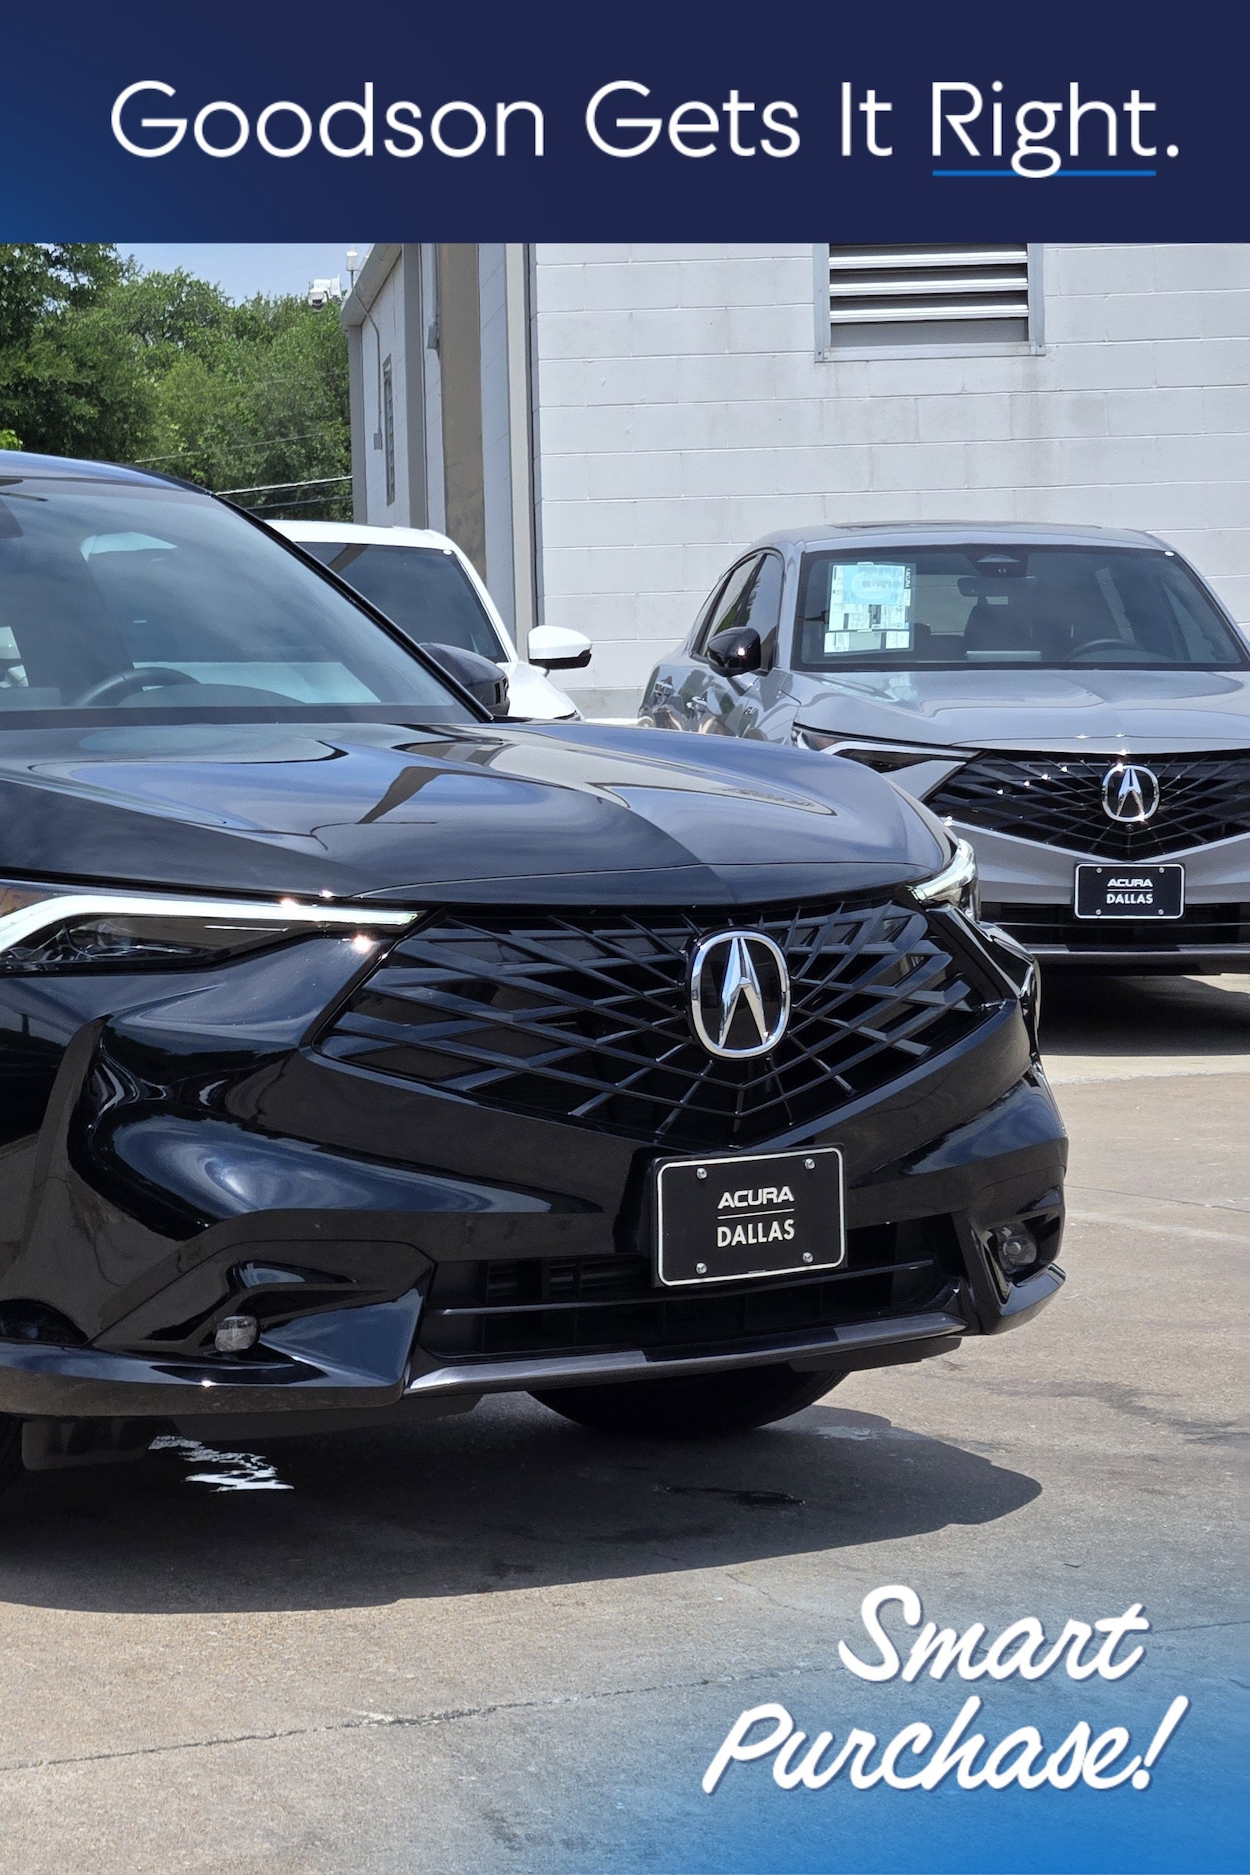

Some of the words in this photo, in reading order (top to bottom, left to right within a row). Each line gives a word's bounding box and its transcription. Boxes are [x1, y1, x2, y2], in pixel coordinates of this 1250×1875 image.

[1107, 878, 1153, 888] ACURA
[1106, 893, 1154, 905] DALLAS
[717, 1185, 795, 1209] ACURA
[717, 1218, 795, 1248] DALLAS
